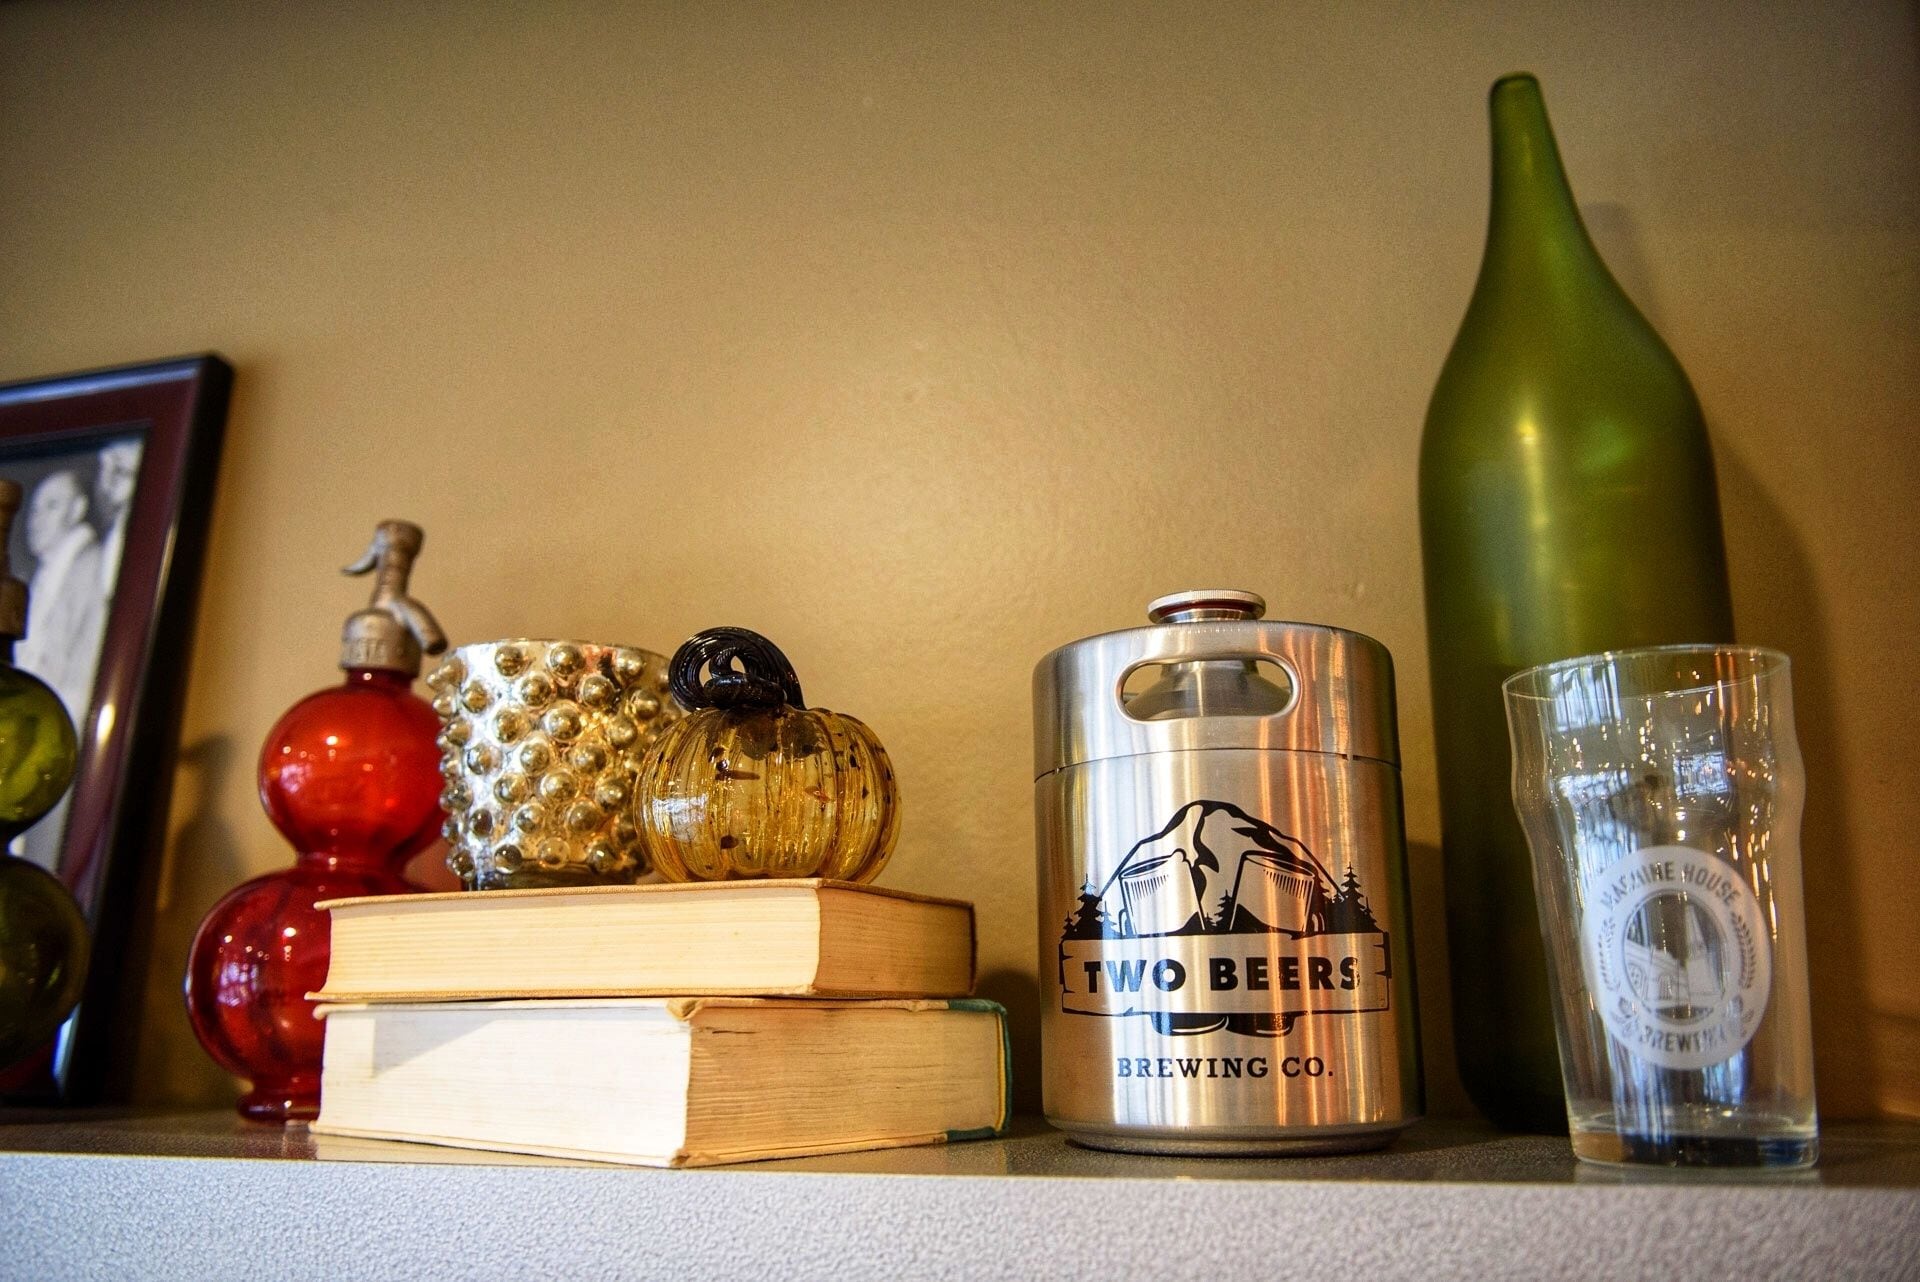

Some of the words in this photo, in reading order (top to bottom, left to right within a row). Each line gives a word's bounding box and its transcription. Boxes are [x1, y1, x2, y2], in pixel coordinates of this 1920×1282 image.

[1682, 863, 1741, 905] HOUSE
[1083, 957, 1187, 994] TWO
[1209, 956, 1362, 992] BEERS
[1639, 1023, 1727, 1053] BREW
[1117, 1057, 1269, 1079] BREWING
[1281, 1055, 1335, 1079] CO.
